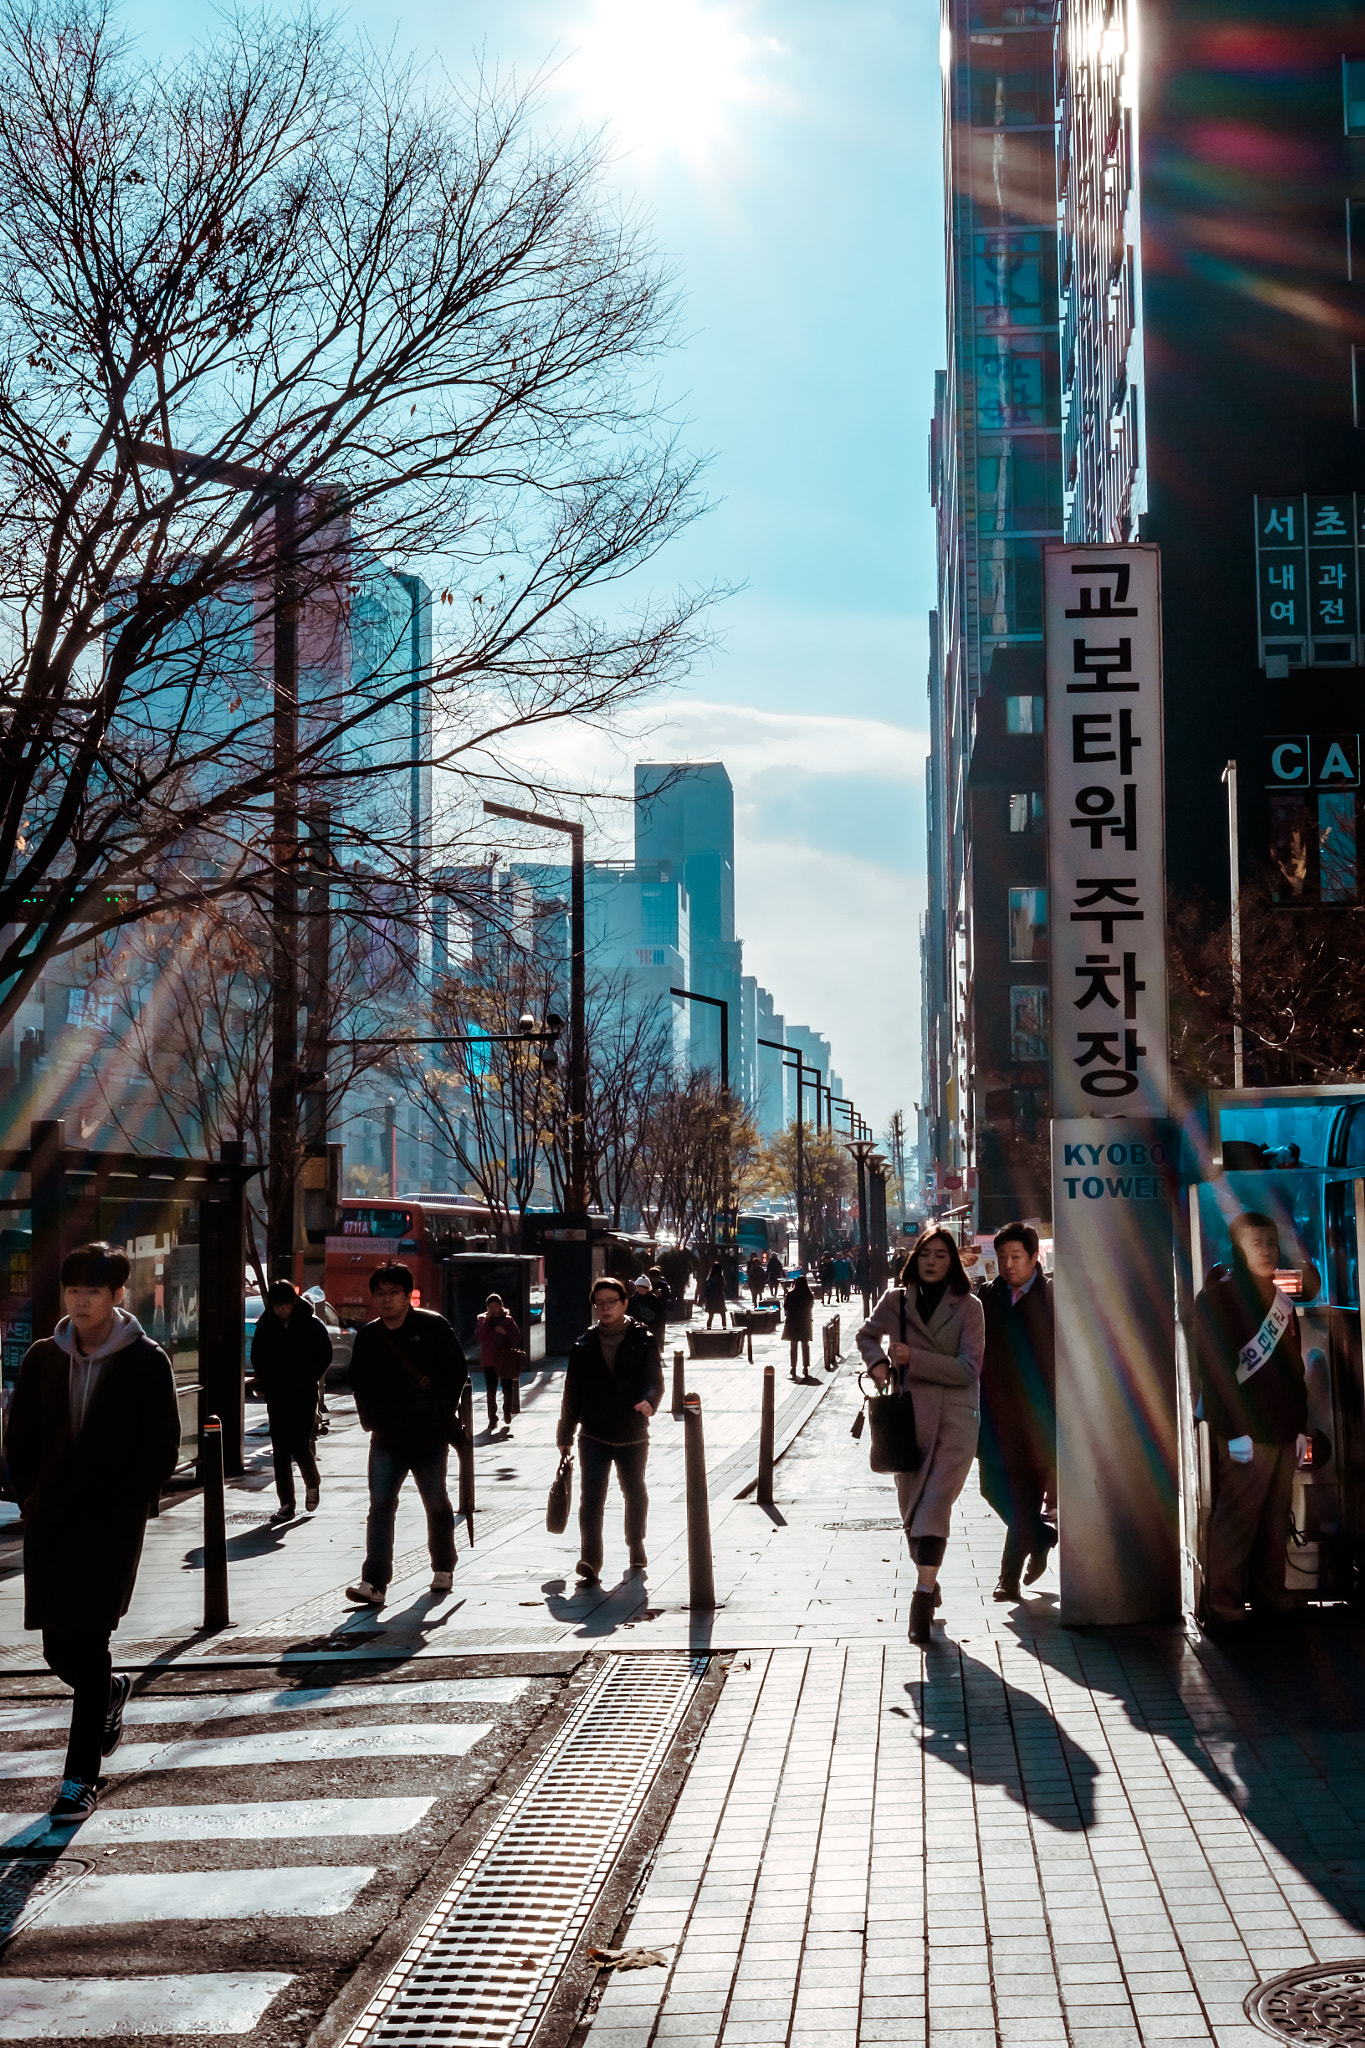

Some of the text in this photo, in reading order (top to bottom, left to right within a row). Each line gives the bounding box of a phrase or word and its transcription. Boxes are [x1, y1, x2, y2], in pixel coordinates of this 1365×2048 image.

[1264, 505, 1365, 541] 서초
[1271, 742, 1355, 780] CA
[1065, 563, 1146, 1098] 교보타워 주차장
[1064, 1143, 1167, 1166] KYOBO
[1063, 1177, 1168, 1199] TOWER
[343, 1221, 368, 1234] 9711A
[1241, 1307, 1285, 1371] 교보타워
